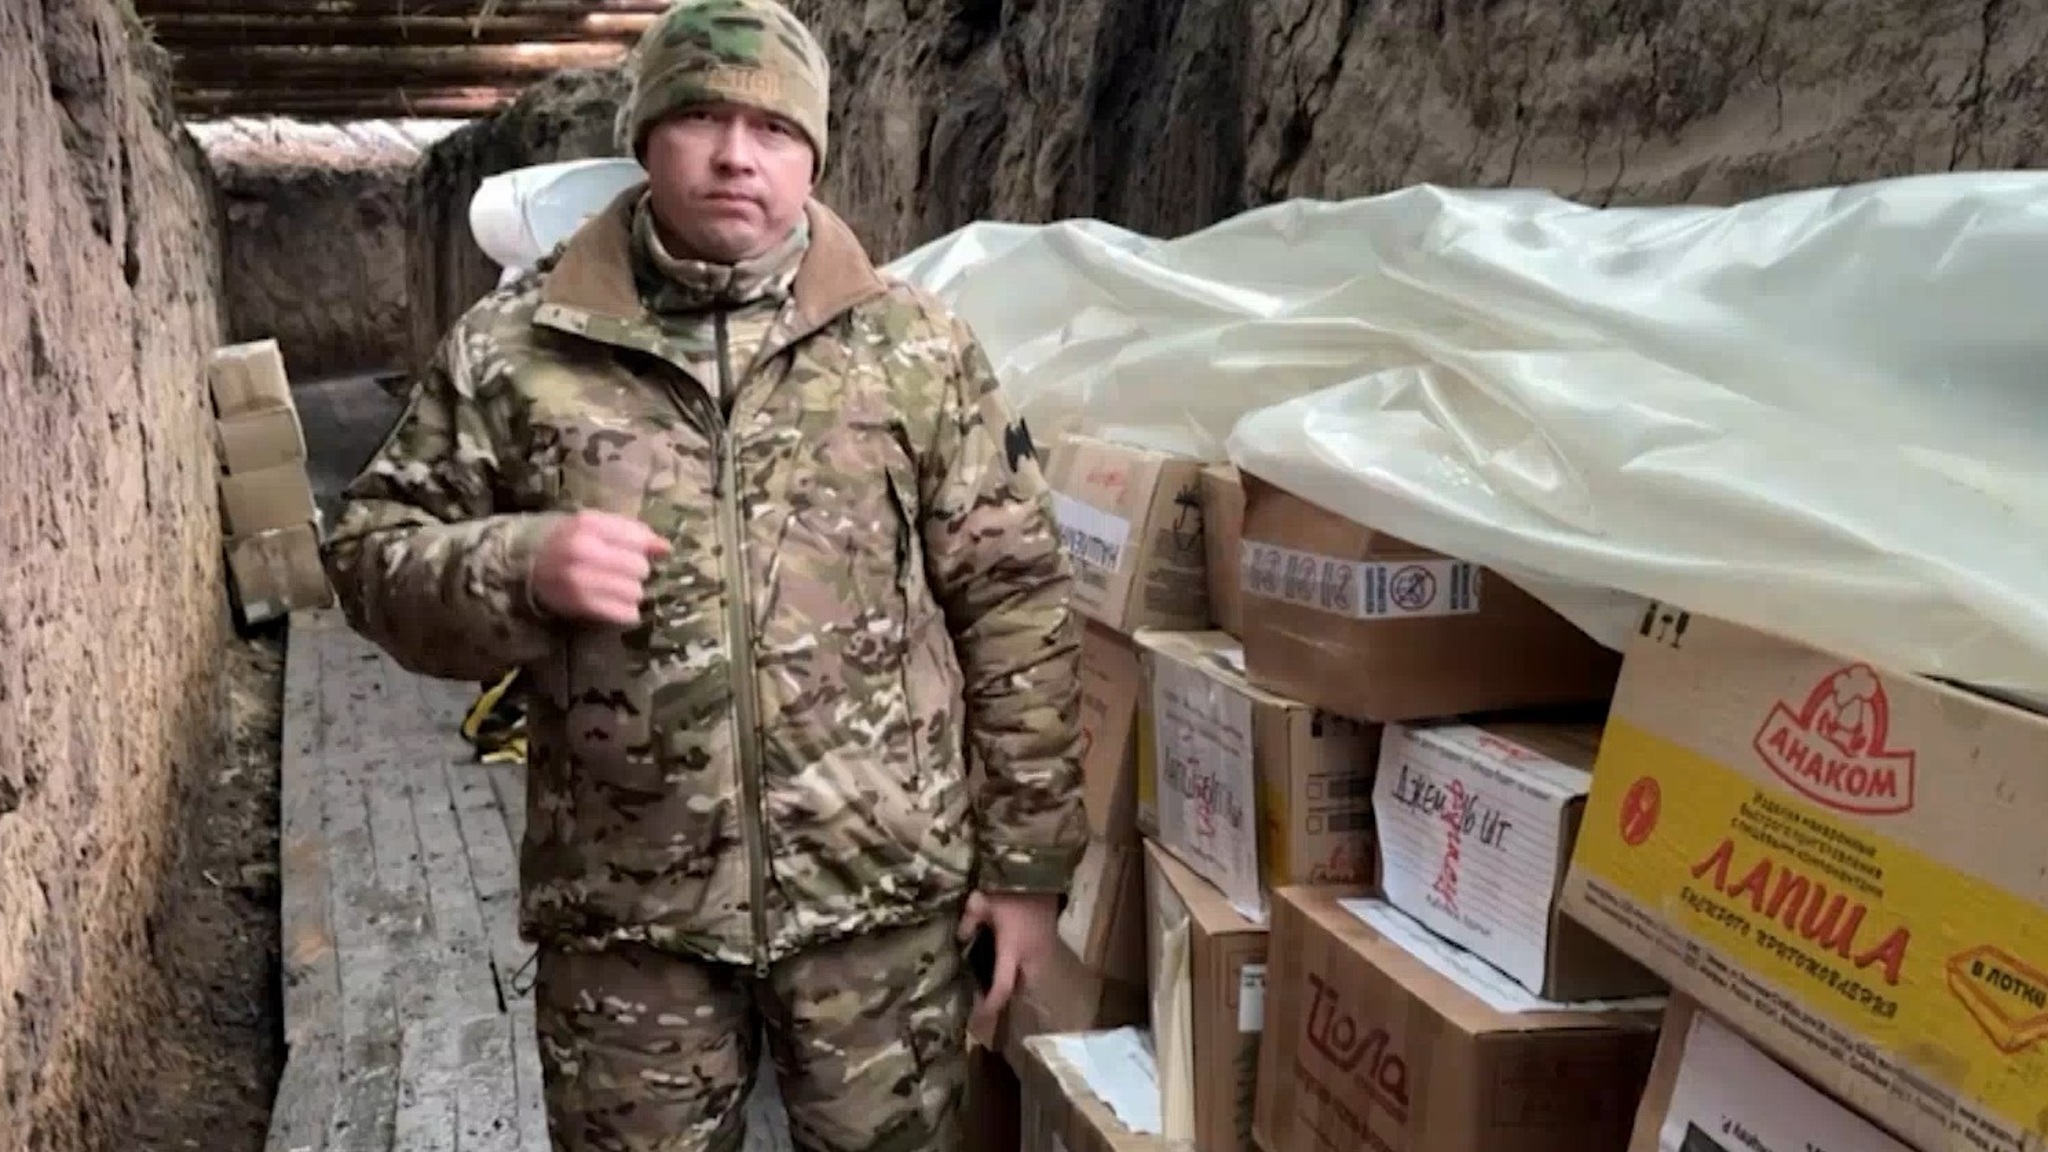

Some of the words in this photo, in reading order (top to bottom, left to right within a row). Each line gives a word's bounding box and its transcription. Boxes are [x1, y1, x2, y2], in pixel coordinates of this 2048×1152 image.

[1768, 726, 1897, 798] АНАКОМ
[1691, 838, 1912, 986] ЛАПША
[1971, 960, 1985, 979] В
